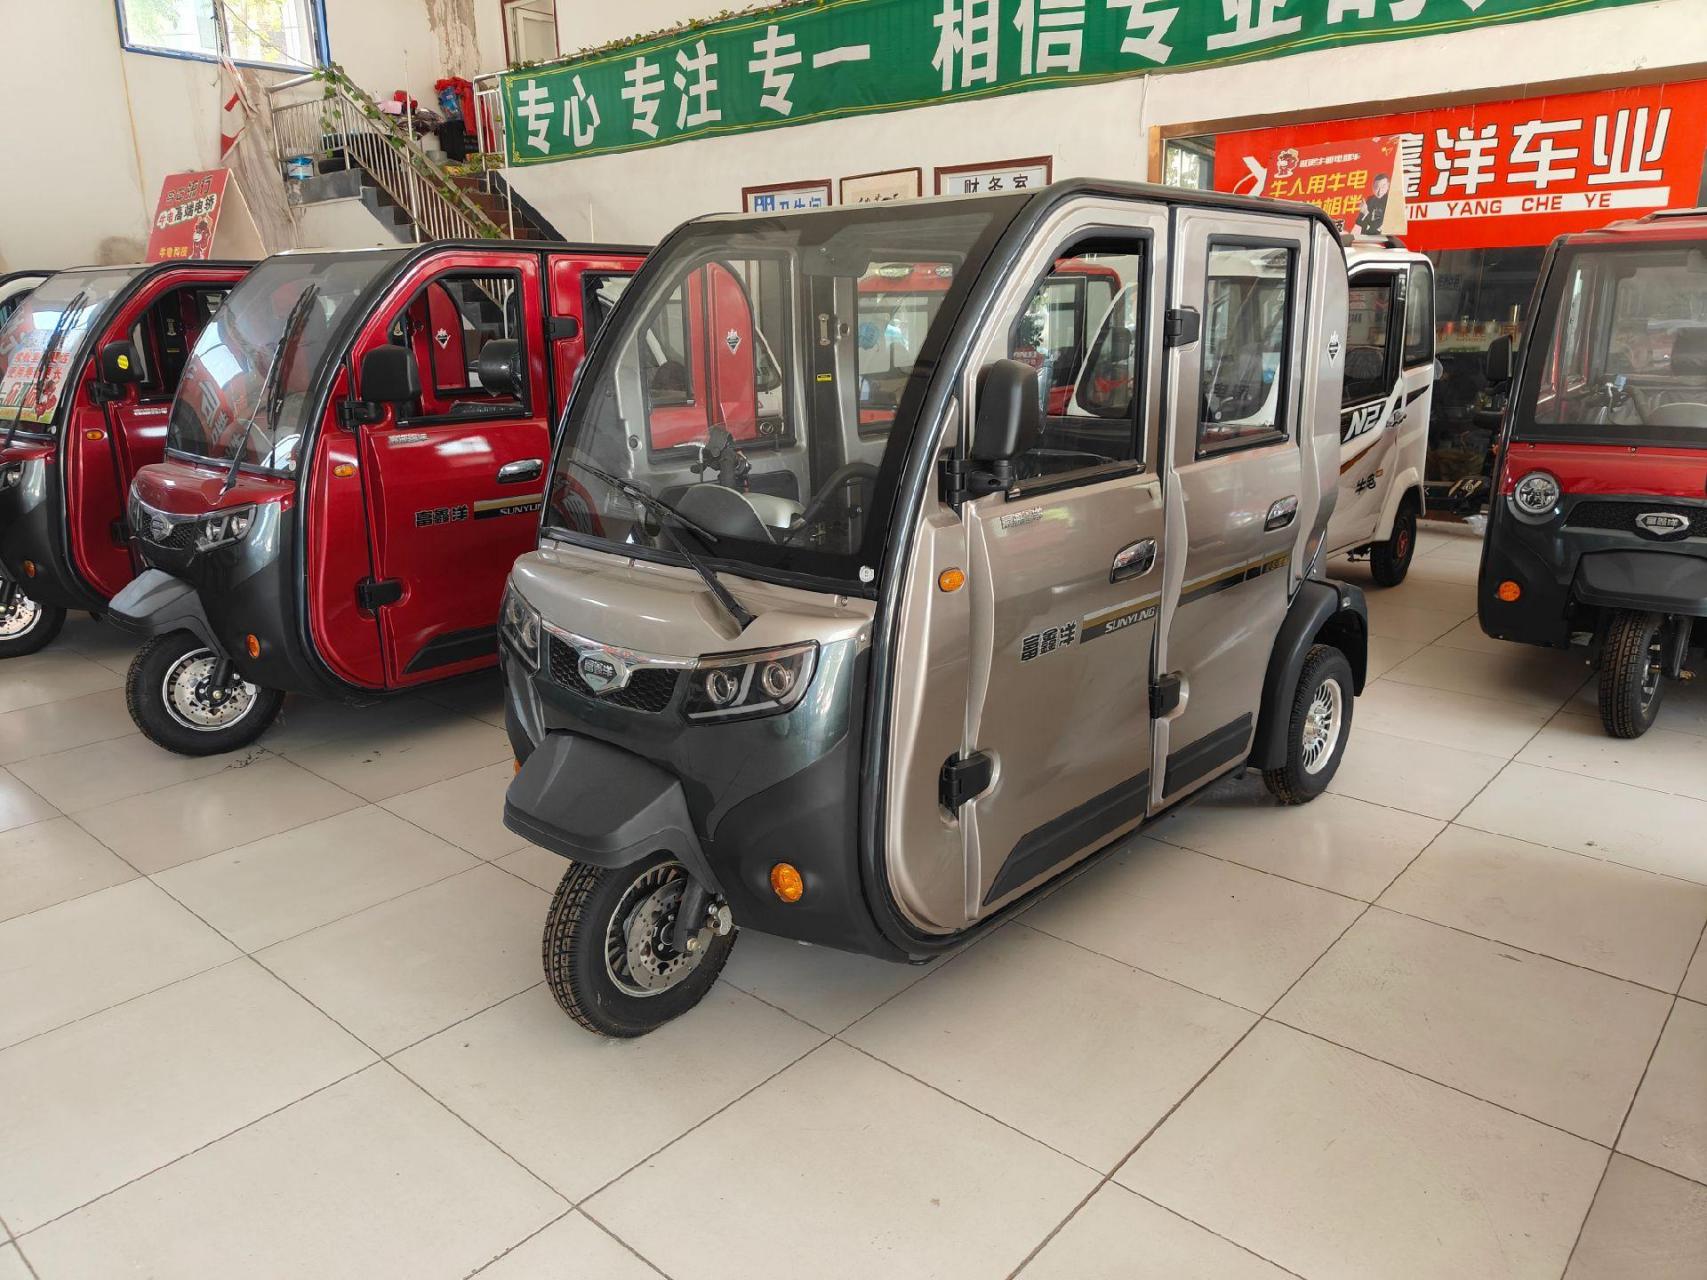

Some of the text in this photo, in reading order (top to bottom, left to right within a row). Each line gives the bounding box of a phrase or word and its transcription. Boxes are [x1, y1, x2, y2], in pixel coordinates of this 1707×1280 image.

[517, 0, 1487, 155] 专心 专注 专一 相信专业
[1270, 169, 1368, 198] 牛人用牛电
[1407, 192, 1612, 219] IN YANG CHE YE
